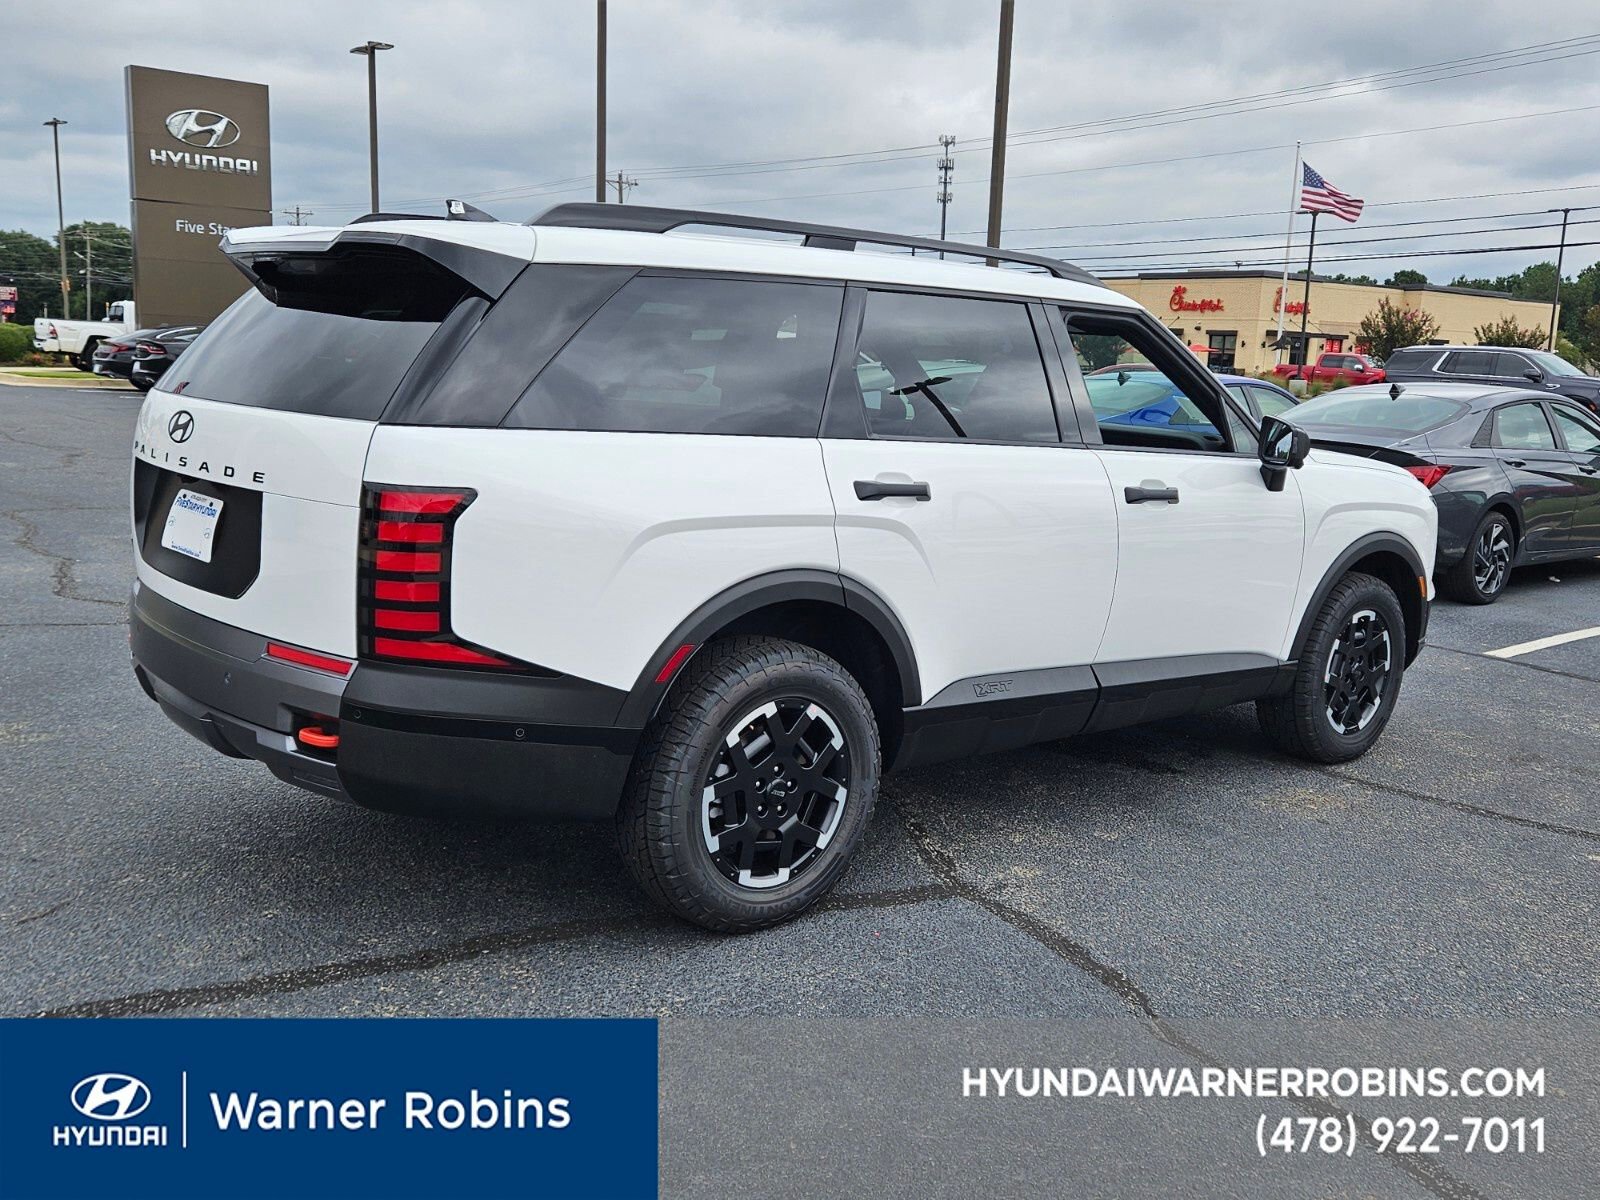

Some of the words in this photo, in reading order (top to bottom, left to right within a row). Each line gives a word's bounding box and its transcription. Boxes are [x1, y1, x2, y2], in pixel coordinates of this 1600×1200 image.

[149, 148, 258, 175] HYUNDAI
[175, 219, 205, 234] Five
[134, 440, 265, 483] PALISADE
[976, 679, 1013, 697] XRT
